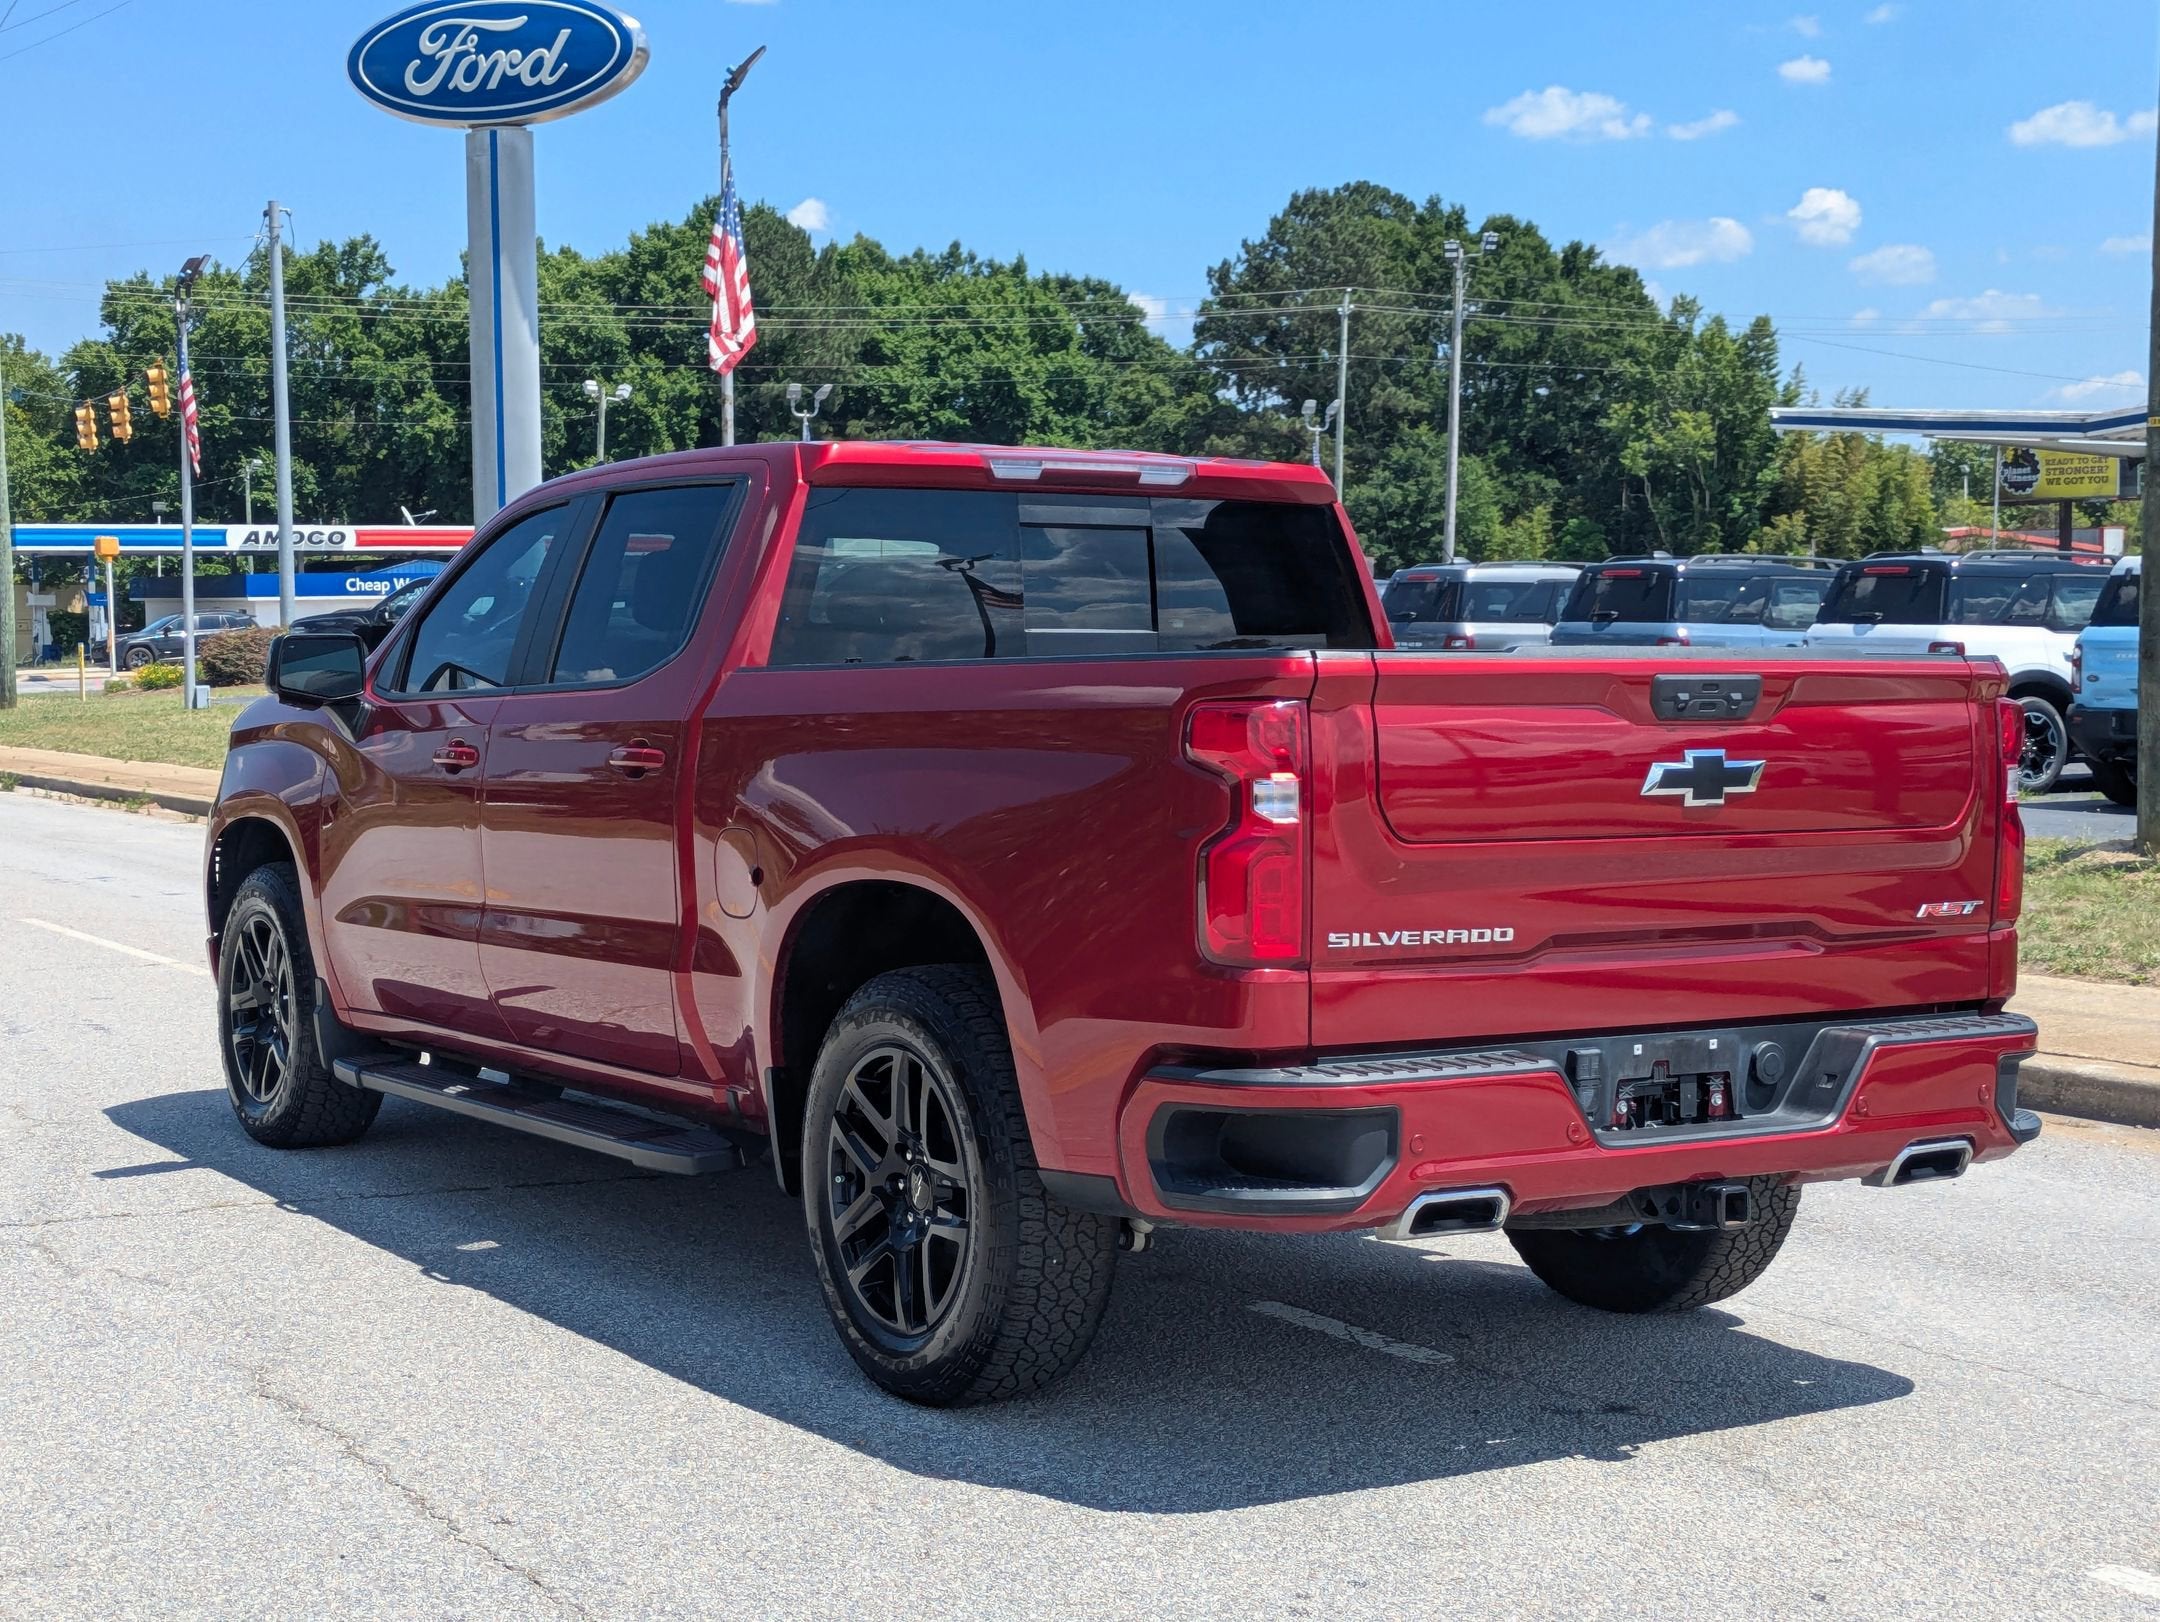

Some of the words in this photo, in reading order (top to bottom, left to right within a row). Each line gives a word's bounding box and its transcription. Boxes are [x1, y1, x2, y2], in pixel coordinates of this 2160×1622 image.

[404, 15, 572, 96] Ford
[2045, 458, 2074, 466] READY
[2077, 457, 2089, 465] TO
[2091, 456, 2109, 464] GET
[2003, 466, 2031, 477] planet
[2045, 466, 2109, 476] STRONGER?
[2008, 474, 2038, 482] fitness
[2045, 477, 2061, 486] WE
[2063, 477, 2085, 485] GOT
[2087, 476, 2109, 484] YOU
[242, 530, 346, 545] AMOCO
[346, 578, 390, 595] Cheap
[1916, 900, 1984, 918] RST
[1327, 927, 1514, 948] SILVERADO
